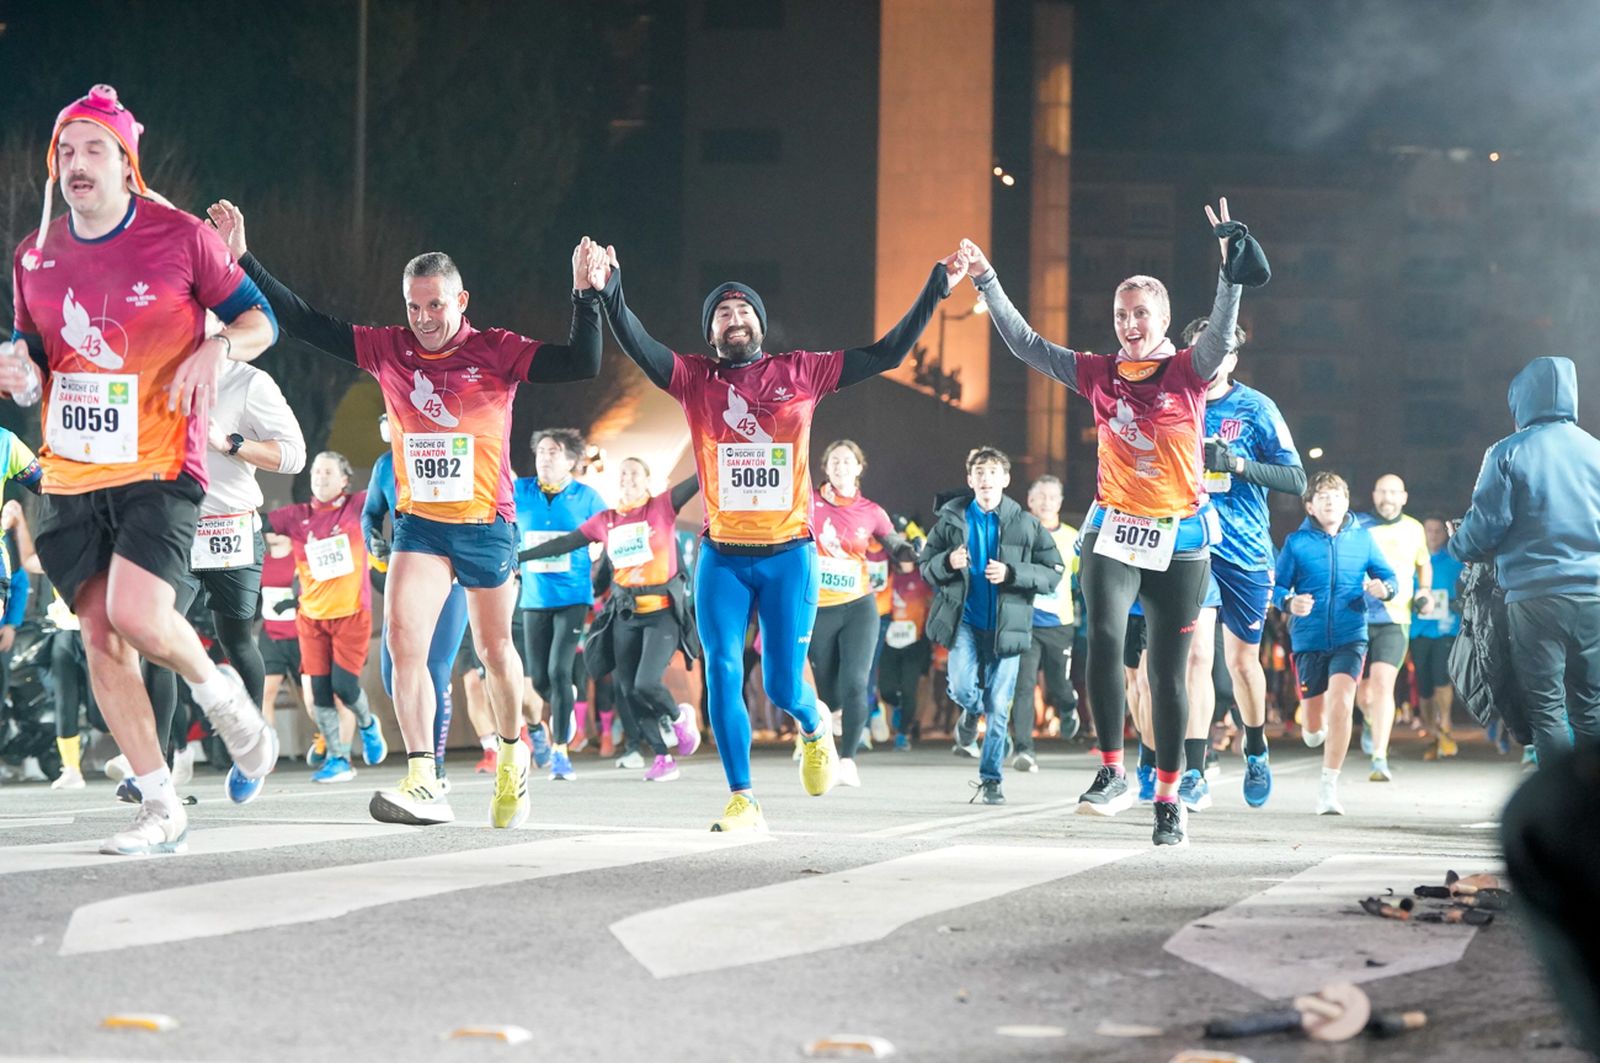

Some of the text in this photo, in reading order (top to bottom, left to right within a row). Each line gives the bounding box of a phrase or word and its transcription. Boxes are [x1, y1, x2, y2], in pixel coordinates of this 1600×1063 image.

[81, 334, 101, 357] 43
[89, 384, 99, 393] DE
[423, 399, 442, 418] 43
[62, 404, 119, 433] 6059
[737, 417, 756, 436] 43
[1120, 423, 1137, 442] 43
[415, 457, 461, 479] 6982
[727, 459, 740, 467] SAN
[731, 467, 780, 488] 5080
[209, 535, 242, 555] 632
[1115, 525, 1161, 549] 5079
[821, 572, 855, 588] 13550
